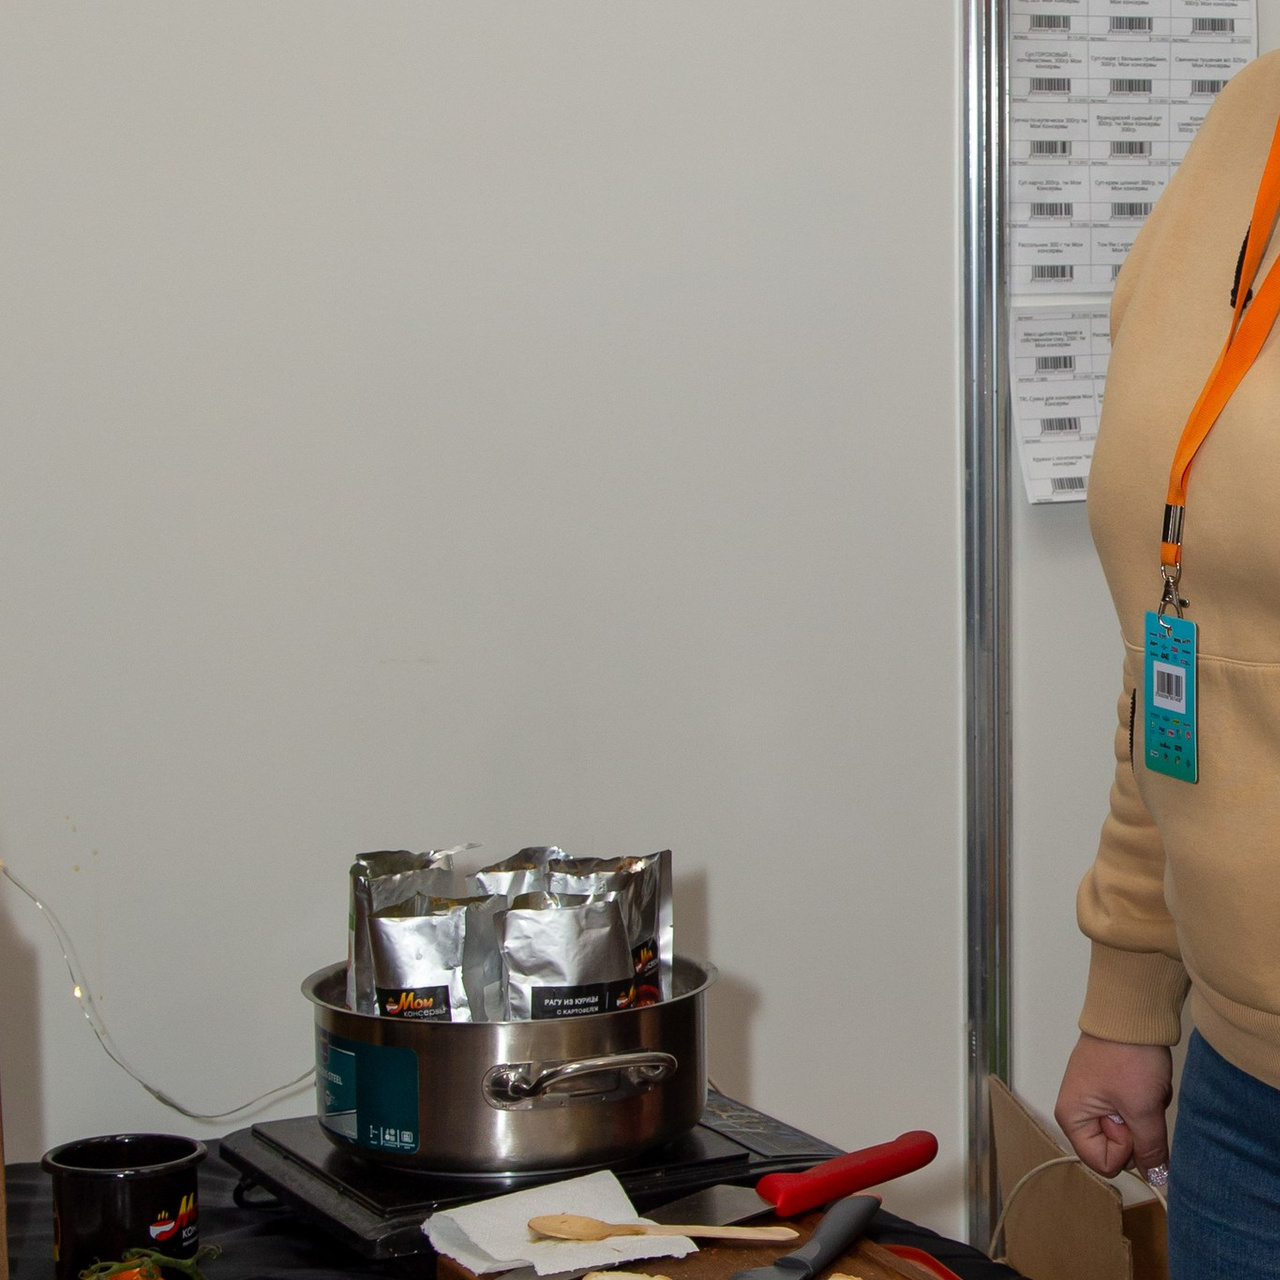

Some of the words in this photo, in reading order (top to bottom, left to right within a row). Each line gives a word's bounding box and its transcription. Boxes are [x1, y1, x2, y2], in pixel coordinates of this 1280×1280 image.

[399, 992, 434, 1010] Мои
[544, 998, 562, 1006] РАГУ
[564, 998, 574, 1006] ИЗ
[575, 996, 599, 1005] КУРИЦЫ
